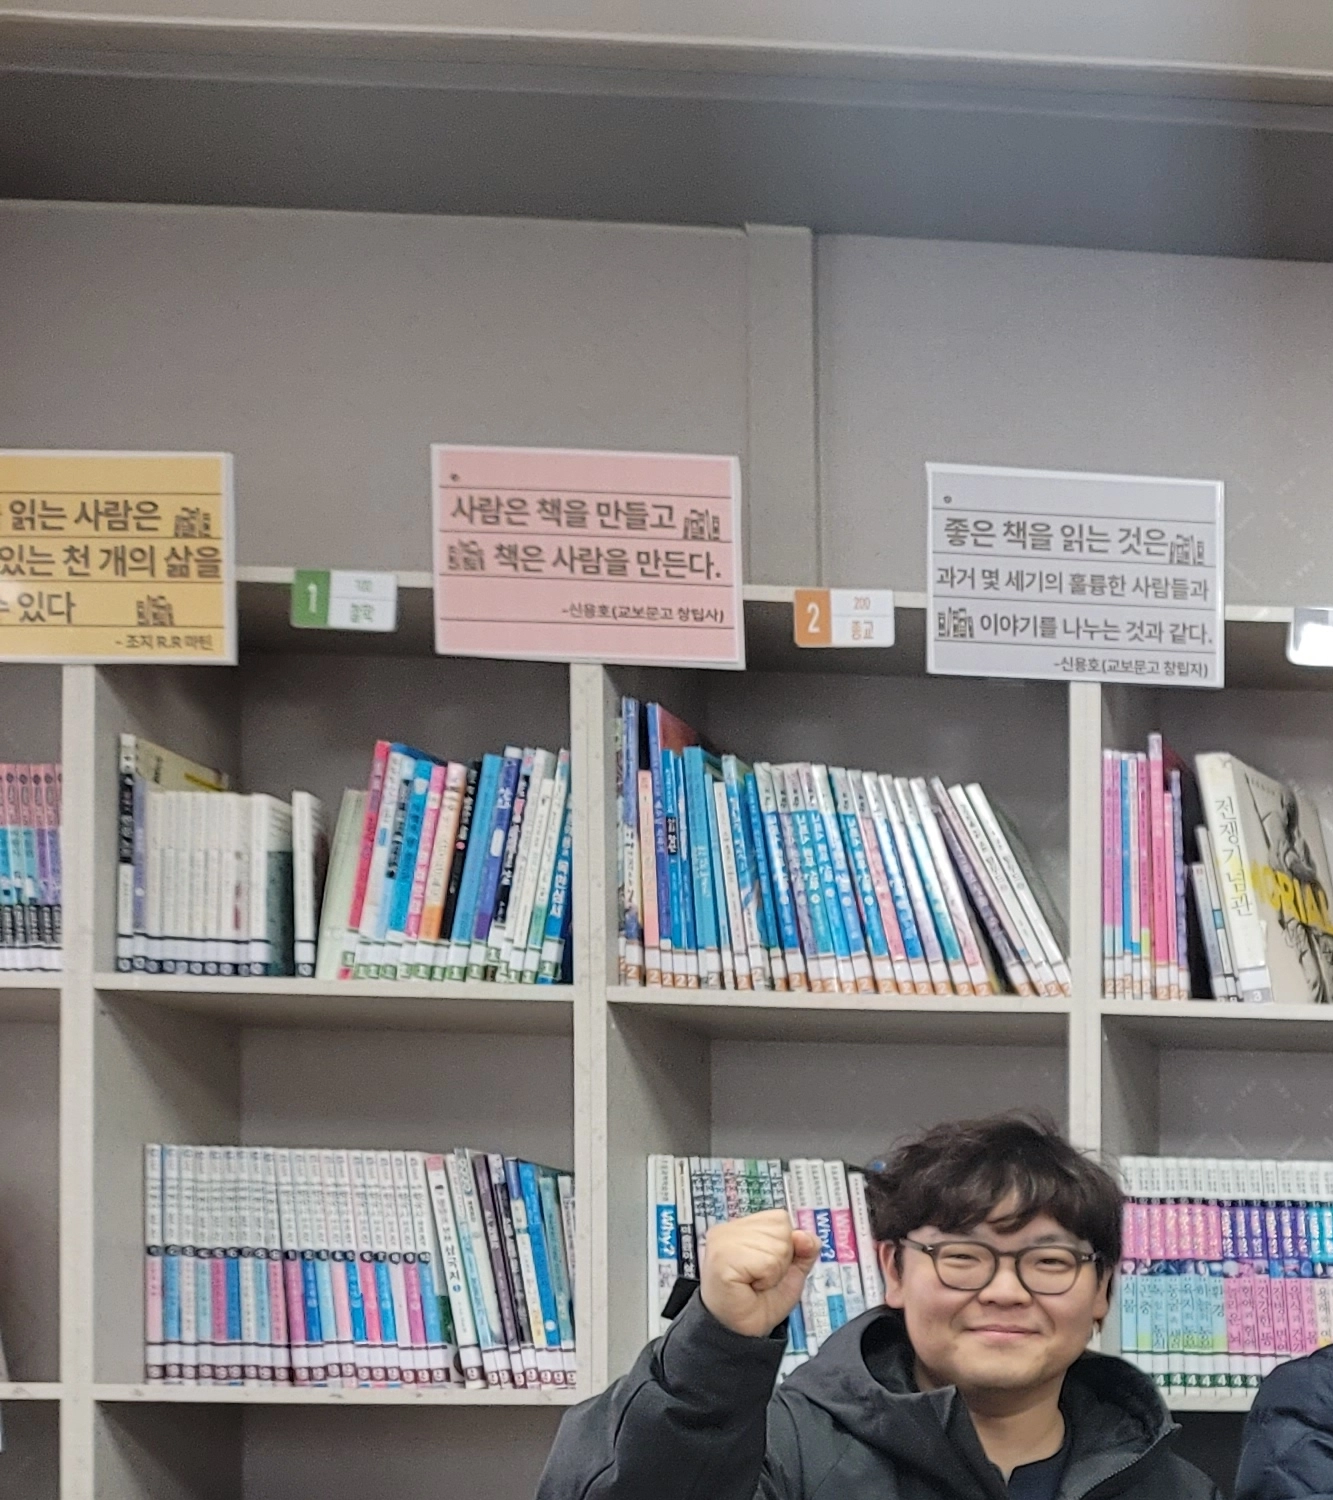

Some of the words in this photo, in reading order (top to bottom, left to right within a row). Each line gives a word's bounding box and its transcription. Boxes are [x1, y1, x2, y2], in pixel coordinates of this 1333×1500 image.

[9, 499, 66, 532] 읽는
[74, 499, 162, 533] 사람은
[451, 495, 531, 527] 사람은
[536, 498, 589, 530] 책을
[596, 501, 678, 532] 만들고
[943, 516, 996, 549] 좋은
[1002, 519, 1054, 552] 책을
[1060, 522, 1111, 555] 읽는
[1117, 525, 1168, 557] 것은
[0, 544, 55, 578] 있는
[63, 544, 91, 577] 천
[99, 544, 155, 578] 개의
[164, 544, 222, 580] 삶을
[494, 543, 546, 574] 책은
[551, 545, 630, 577] 사람을
[636, 550, 722, 581] 만든다.
[307, 582, 318, 614] 1
[935, 566, 976, 590] 과거
[981, 568, 999, 594] 몇
[1004, 569, 1064, 595] 세기의
[1068, 572, 1126, 599] 훌륭한
[1130, 575, 1210, 602] 사람들과
[17, 591, 76, 624] 있다
[807, 602, 821, 633] 2
[852, 620, 874, 641] 종교
[979, 612, 1058, 641] 이야기를
[1062, 616, 1121, 642] 나누는
[1125, 618, 1166, 645] 것과
[1169, 620, 1213, 647] 같다.
[1213, 796, 1253, 917] 전쟁기념관
[659, 1208, 676, 1256] Why?
[819, 1211, 836, 1262] Why?
[839, 1213, 856, 1262] Why?
